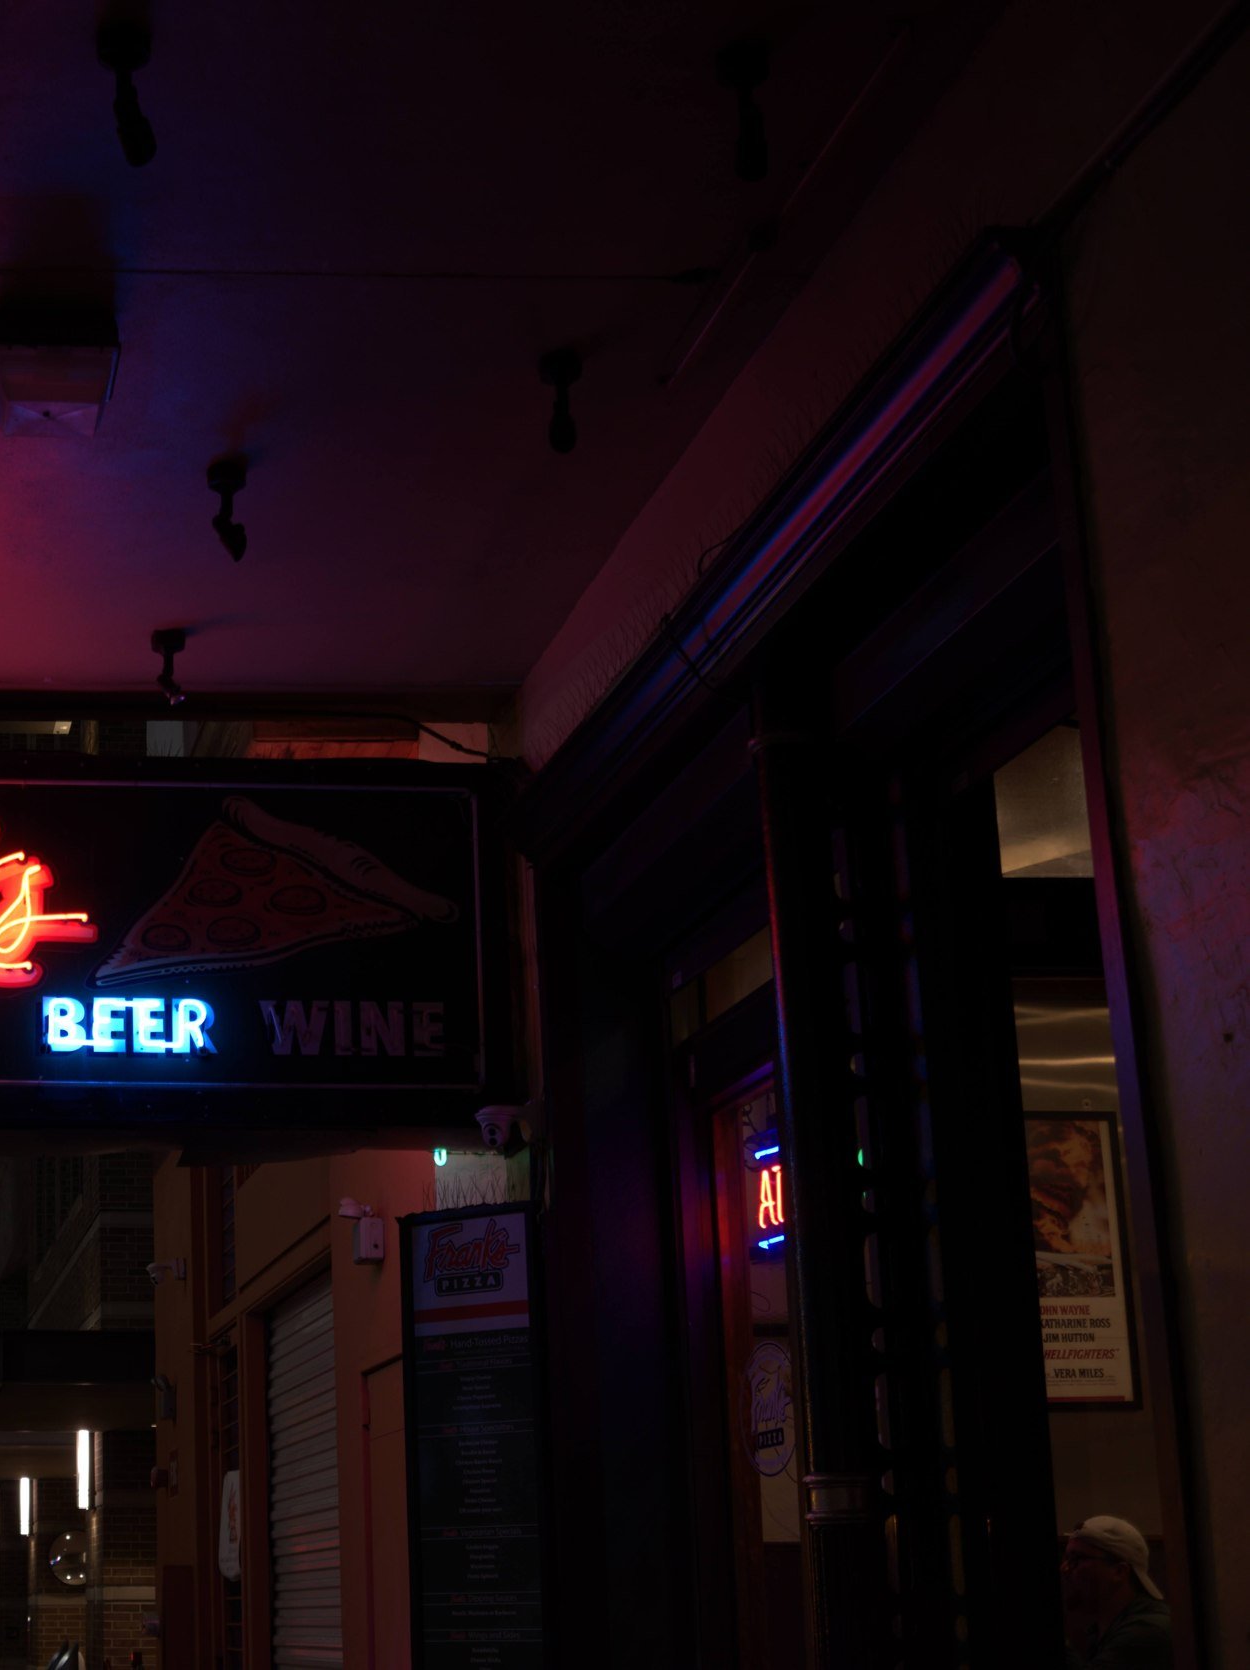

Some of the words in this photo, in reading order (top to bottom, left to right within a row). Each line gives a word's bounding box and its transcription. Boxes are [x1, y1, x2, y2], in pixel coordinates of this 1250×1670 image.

[41, 996, 220, 1055] BEER
[257, 998, 448, 1057] WINE
[758, 1164, 784, 1229] AT
[440, 1274, 498, 1292] PIZZA
[1040, 1304, 1058, 1315] OHN
[1059, 1304, 1090, 1315] WAYNE
[1089, 1318, 1111, 1328] ROSS
[1043, 1333, 1060, 1343] JIM
[1061, 1333, 1096, 1343] HUTTON
[1054, 1368, 1077, 1378] VERA
[1078, 1368, 1104, 1378] MILES
